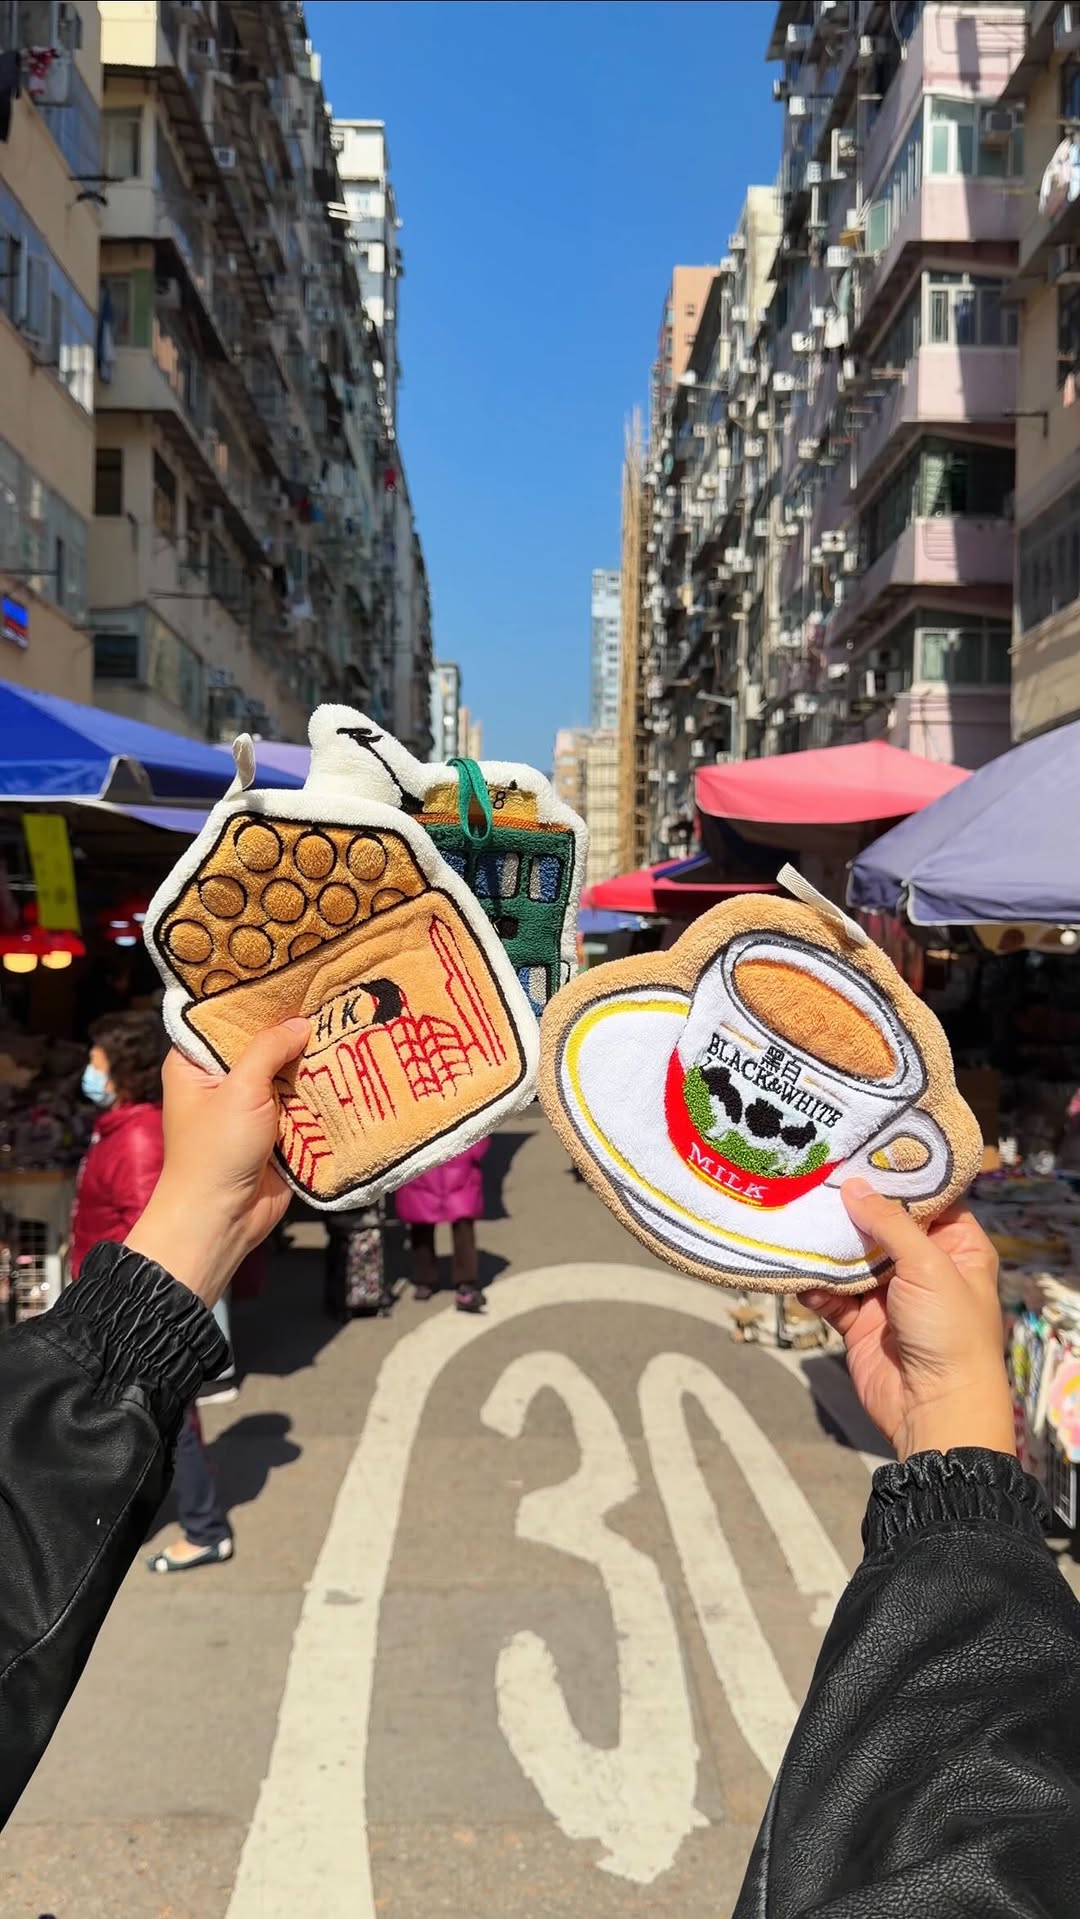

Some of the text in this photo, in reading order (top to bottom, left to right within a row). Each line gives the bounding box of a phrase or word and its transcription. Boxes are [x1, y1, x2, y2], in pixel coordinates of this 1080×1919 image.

[316, 993, 362, 1043] HK
[707, 1033, 843, 1129] BLACK&WHITE
[760, 1045, 802, 1085] 黑白
[688, 1142, 769, 1199] MILK
[480, 1350, 851, 1884] 30
